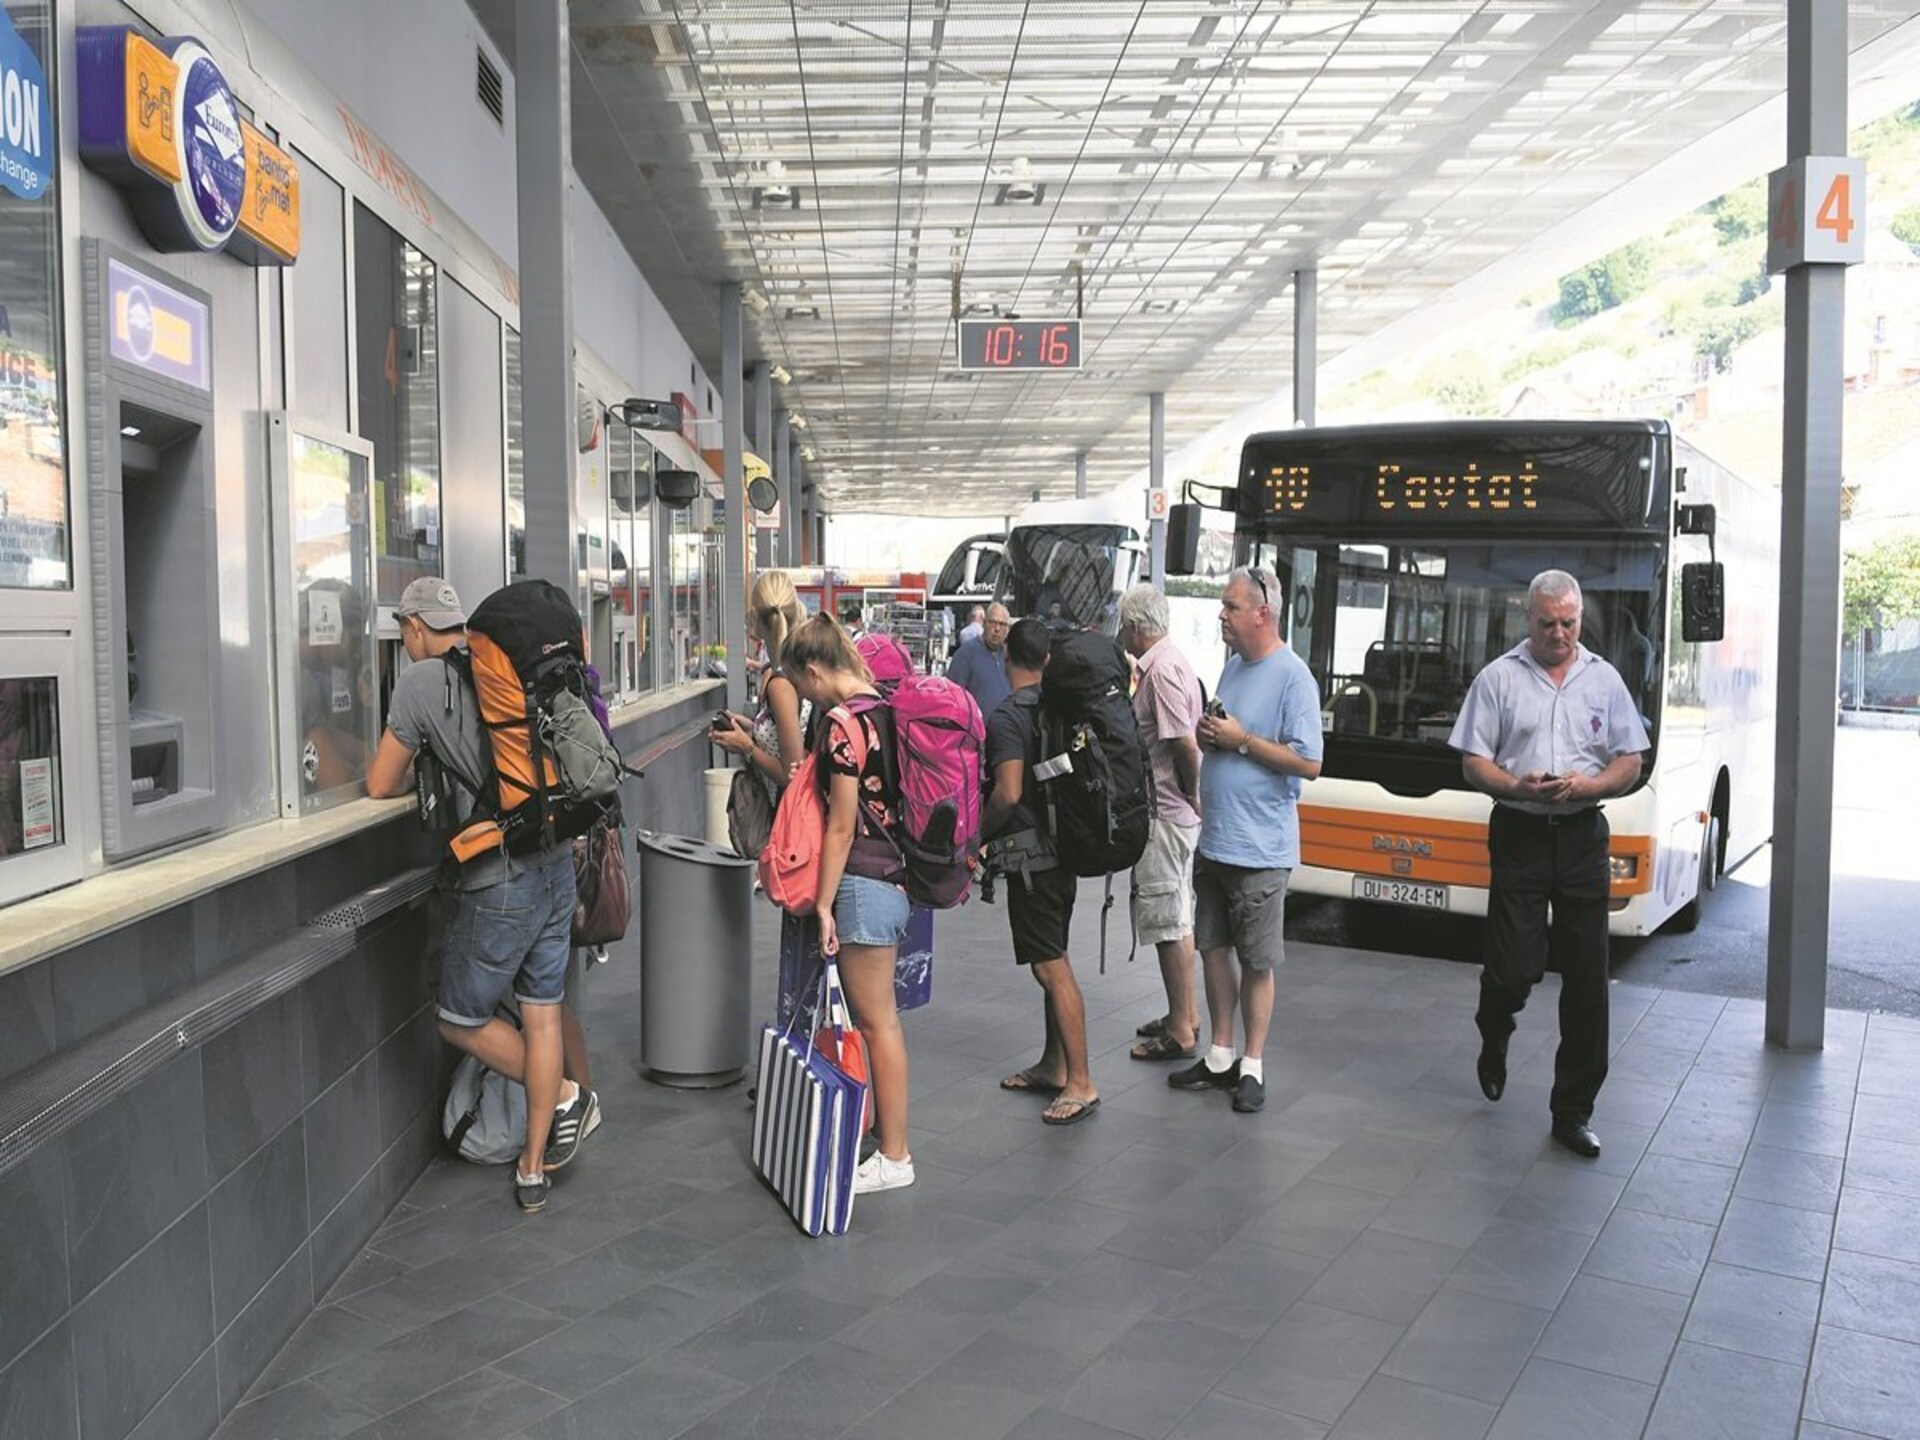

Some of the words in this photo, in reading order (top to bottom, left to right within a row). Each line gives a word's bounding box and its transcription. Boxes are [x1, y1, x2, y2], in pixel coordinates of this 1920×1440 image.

[0, 149, 38, 190] hange
[1773, 178, 1799, 249] 4
[1816, 173, 1854, 244] 4
[984, 325, 1069, 365] 10:16
[1152, 492, 1165, 514] 3
[1265, 466, 1310, 510] 10
[1377, 461, 1540, 509] Cavtat
[1373, 833, 1434, 856] MAN
[1364, 881, 1382, 899] DU
[1391, 883, 1444, 906] 324-EM
